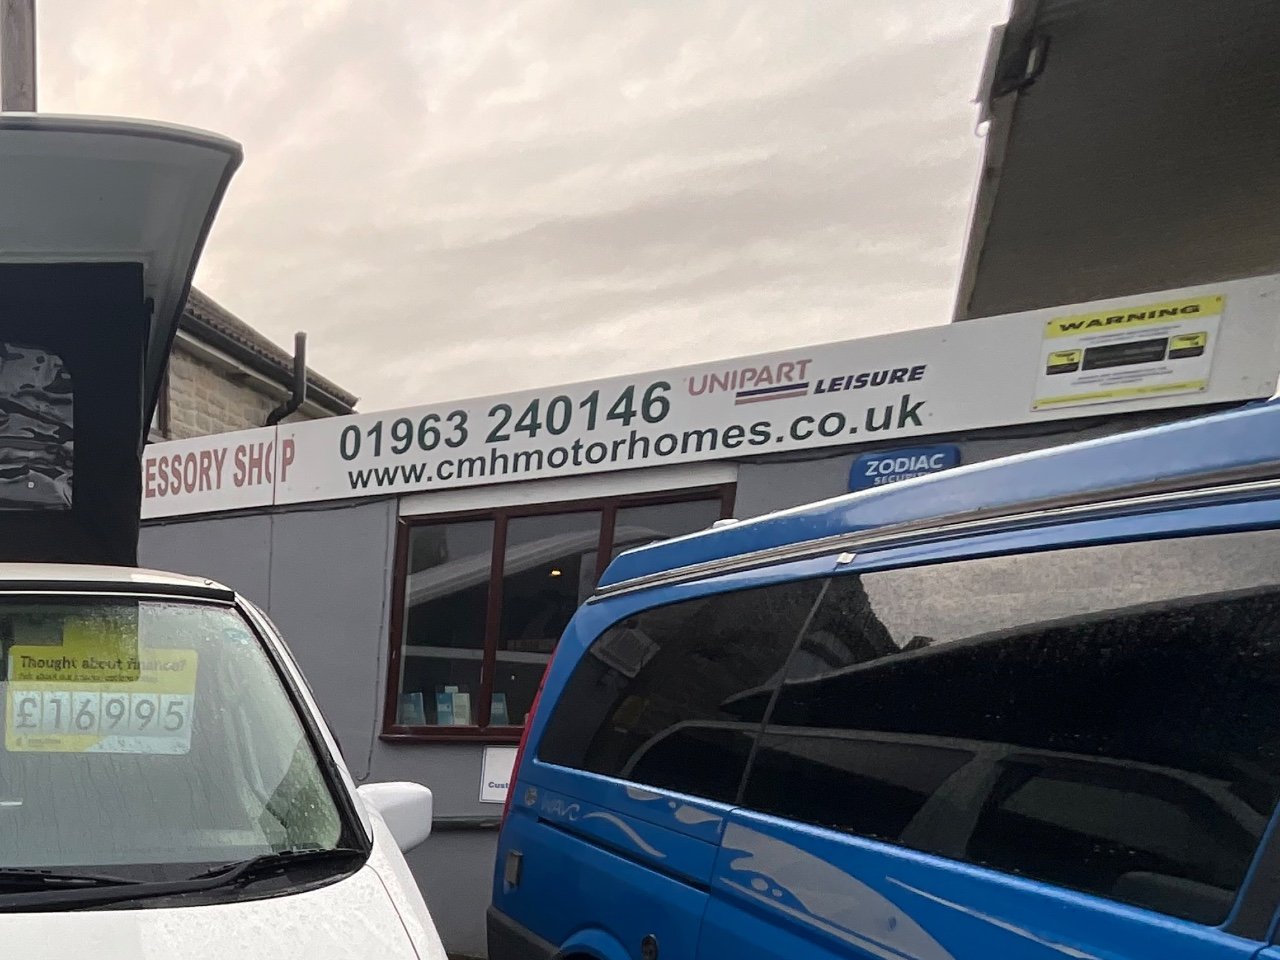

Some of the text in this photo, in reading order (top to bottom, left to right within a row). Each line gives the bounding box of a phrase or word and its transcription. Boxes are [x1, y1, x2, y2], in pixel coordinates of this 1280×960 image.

[1059, 304, 1201, 332] WARNING
[688, 359, 928, 396] UNIPART LEISURE
[339, 381, 672, 461] 01963 240146
[348, 394, 926, 489] www.cmhmotorhomes.co.uk
[865, 453, 945, 476] ZODIAC
[20, 655, 78, 672] Thought
[16, 697, 185, 732] £16995
